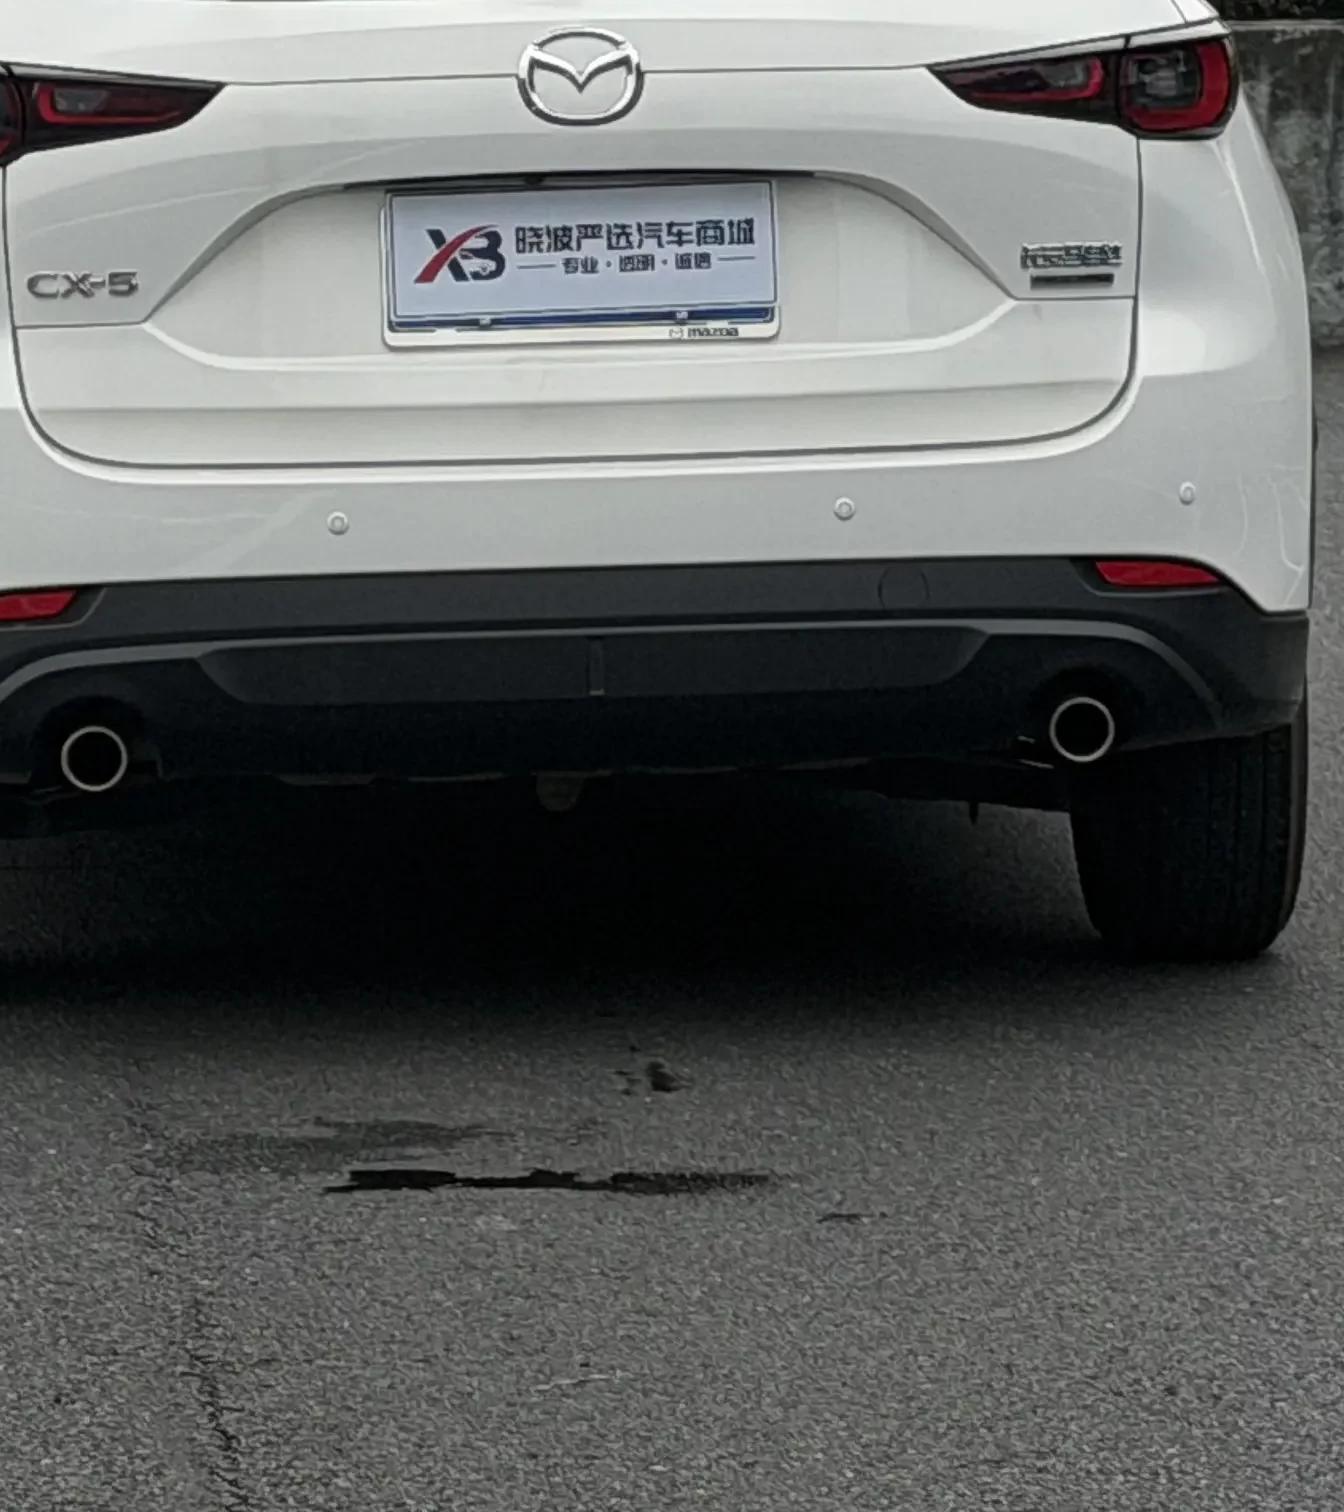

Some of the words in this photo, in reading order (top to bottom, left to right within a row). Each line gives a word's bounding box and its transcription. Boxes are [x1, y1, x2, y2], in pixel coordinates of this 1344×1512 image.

[515, 217, 755, 254] 晓波严选汽车商城
[26, 271, 138, 299] CX-5
